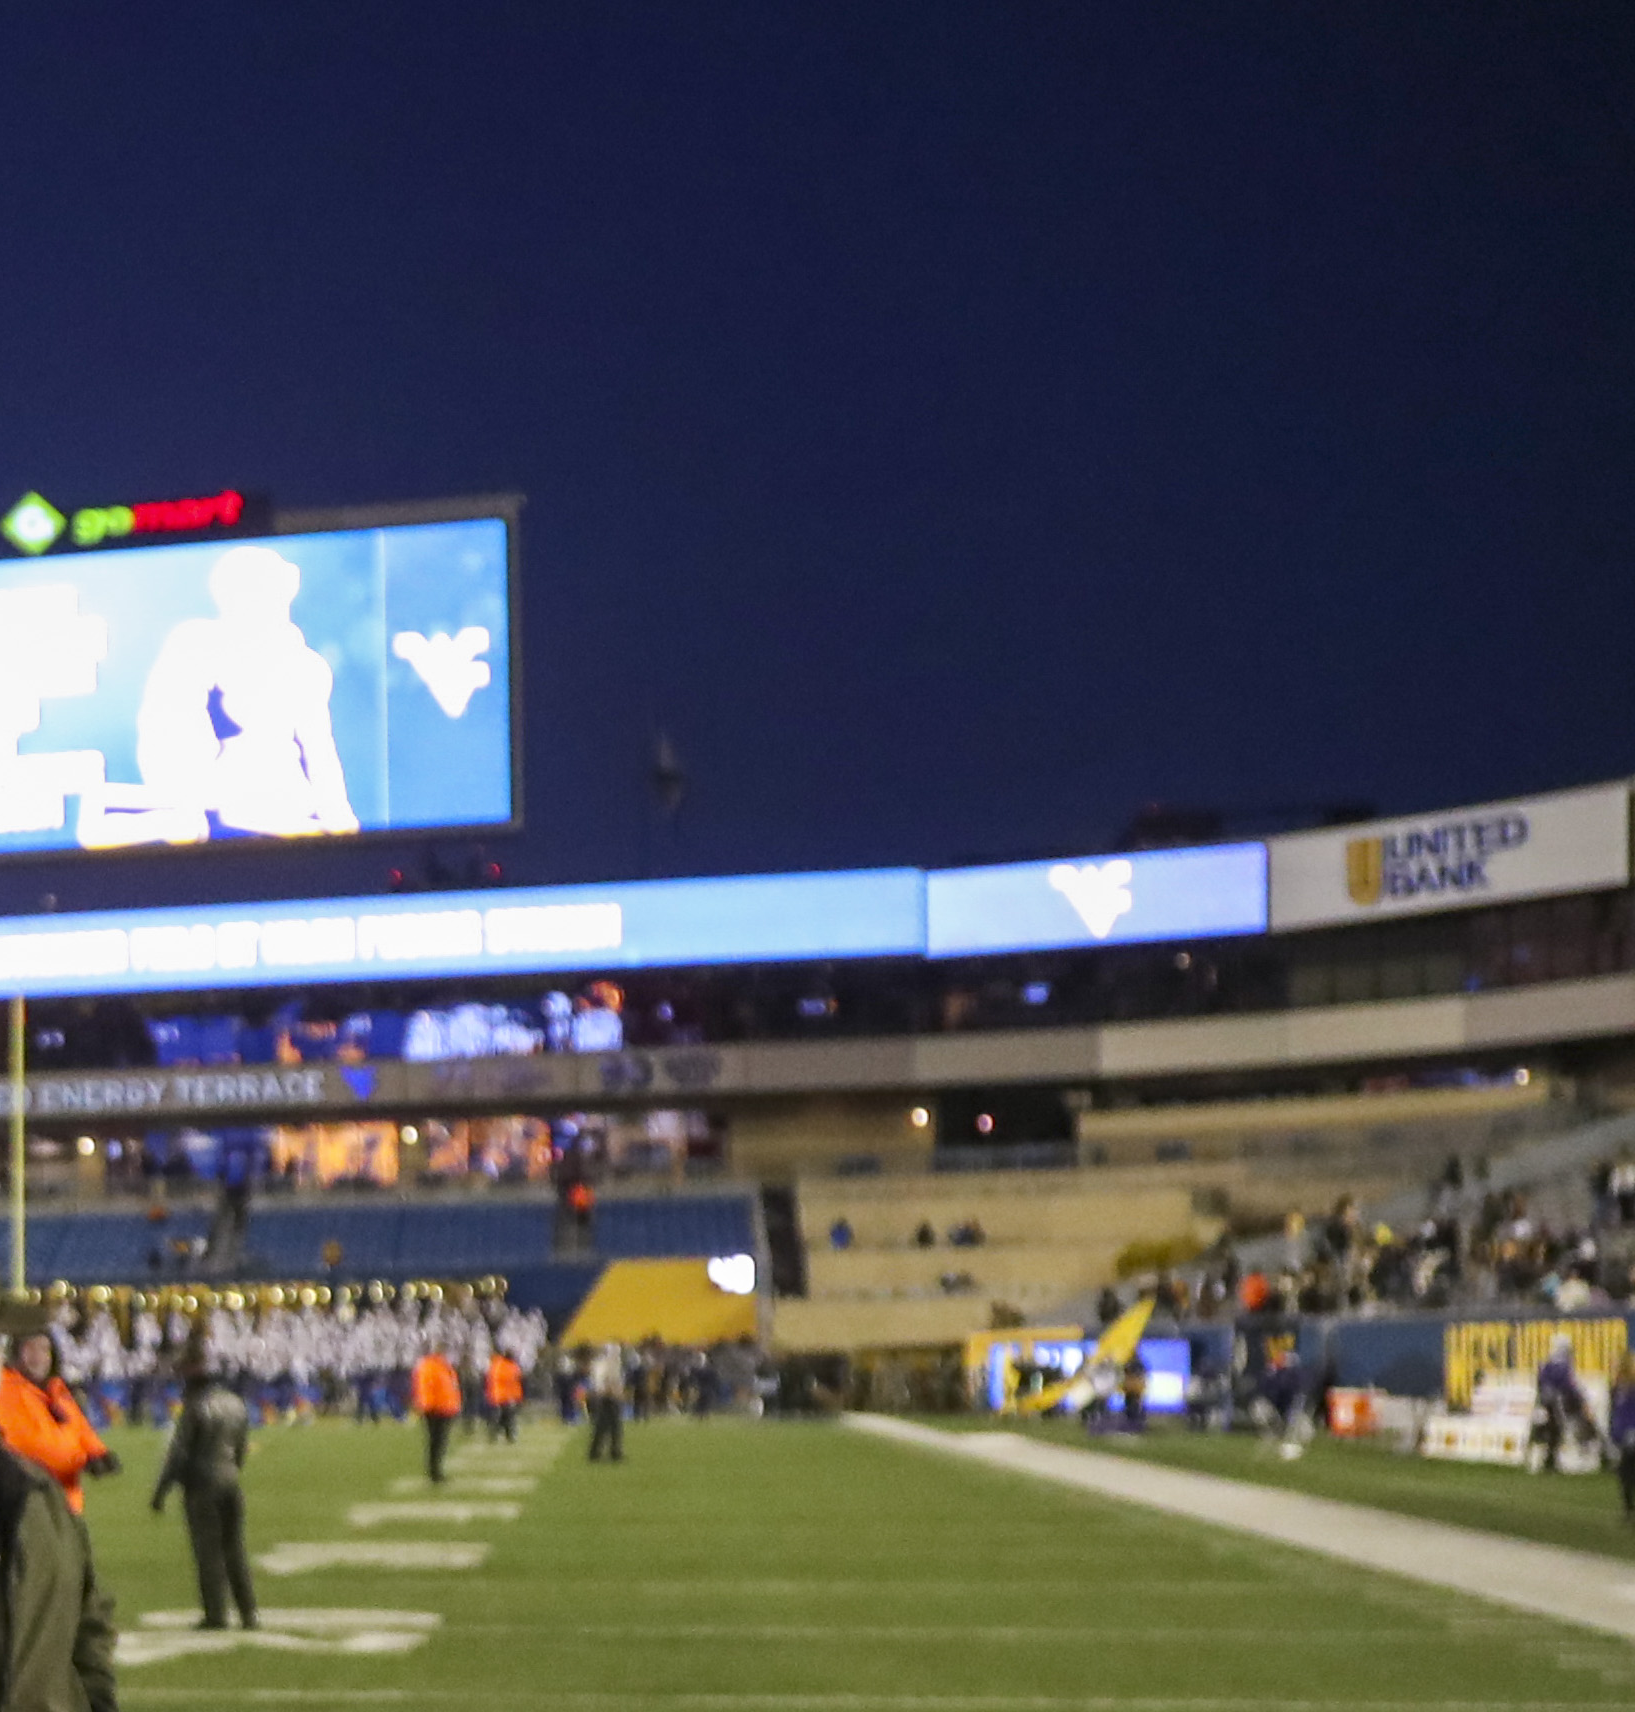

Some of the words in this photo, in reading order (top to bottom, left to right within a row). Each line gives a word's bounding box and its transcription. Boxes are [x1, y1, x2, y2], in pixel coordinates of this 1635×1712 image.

[1383, 809, 1529, 857] UNITED
[1383, 861, 1489, 897] BANK
[40, 1078, 168, 1112] ENERGY
[173, 1070, 325, 1104] TERRACE
